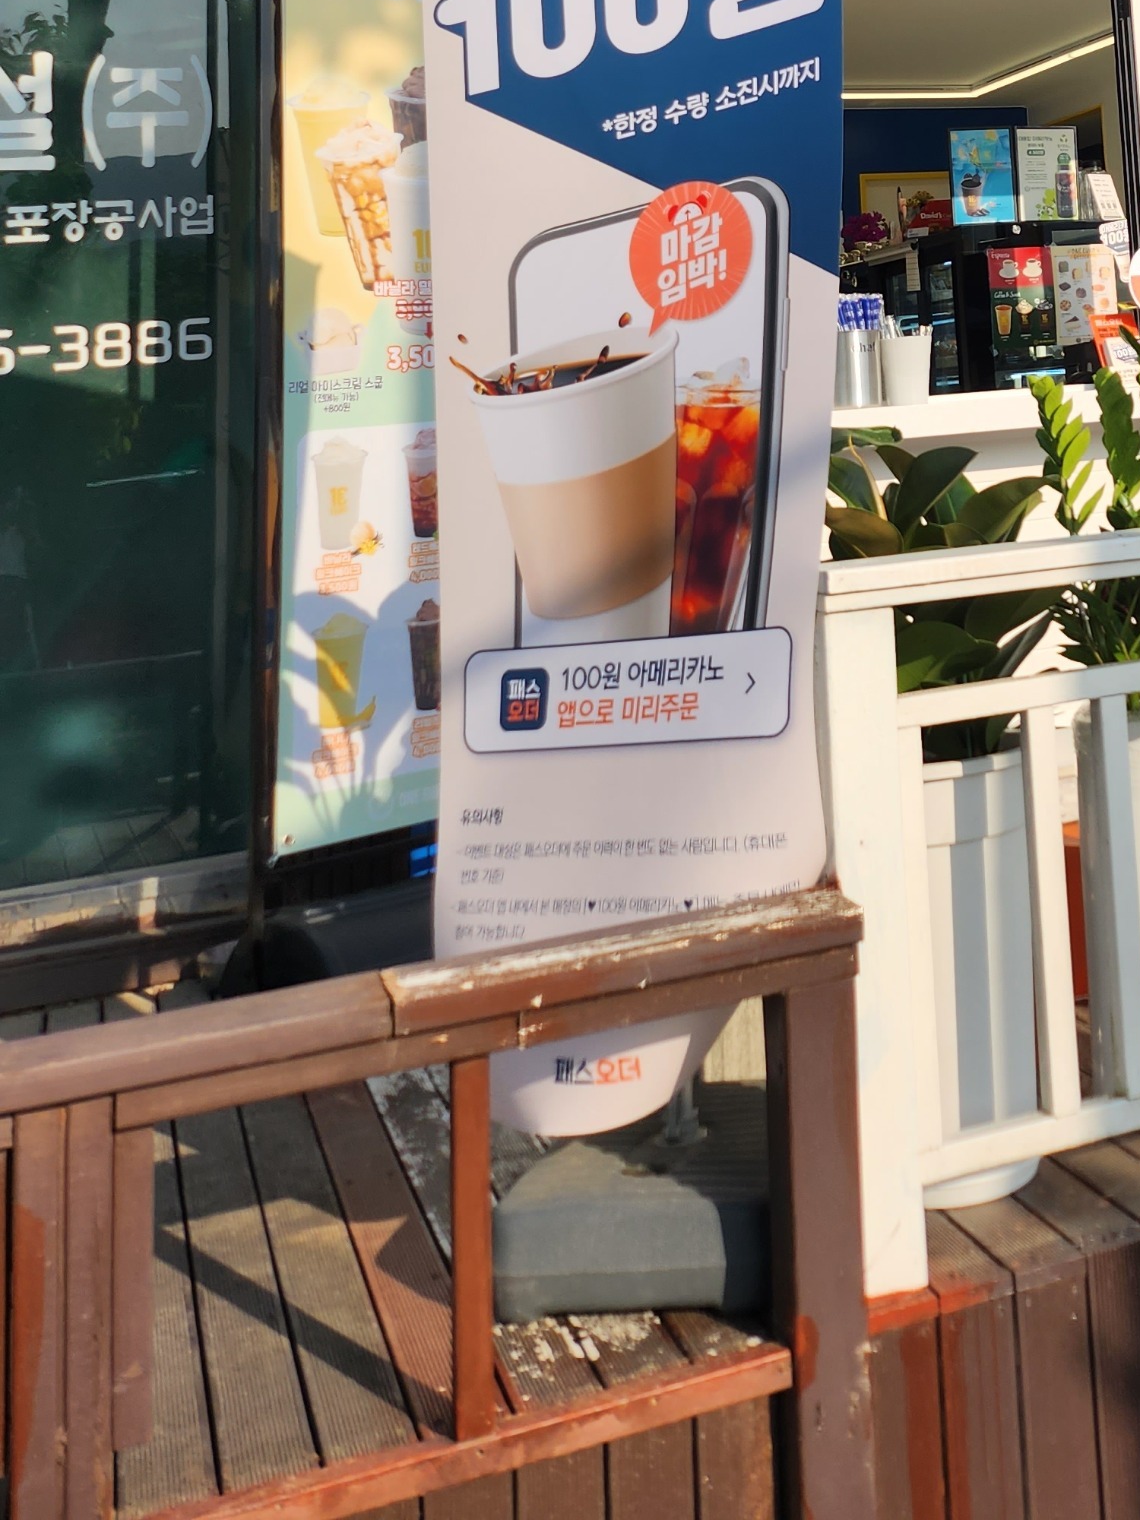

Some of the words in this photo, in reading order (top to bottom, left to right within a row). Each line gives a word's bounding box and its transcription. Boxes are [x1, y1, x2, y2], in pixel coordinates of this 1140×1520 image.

[664, 92, 711, 126] 수량
[715, 57, 821, 113] 소진시까지
[4, 194, 215, 245] 포장공사업
[660, 211, 723, 266] 마감
[373, 280, 417, 297] 바닐라
[657, 248, 727, 307] 임박!
[289, 380, 309, 394] 리얼
[311, 377, 362, 392] 아이스크림
[365, 376, 383, 389] 스쿱
[323, 402, 351, 413] +800원
[508, 678, 541, 700] 패스
[562, 661, 621, 691] 100원
[627, 655, 724, 688] 아메리카노
[506, 698, 540, 723] 오더
[557, 698, 615, 729] 앱으로
[621, 691, 700, 725] 미리주문
[555, 1057, 642, 1085] 패스오더
